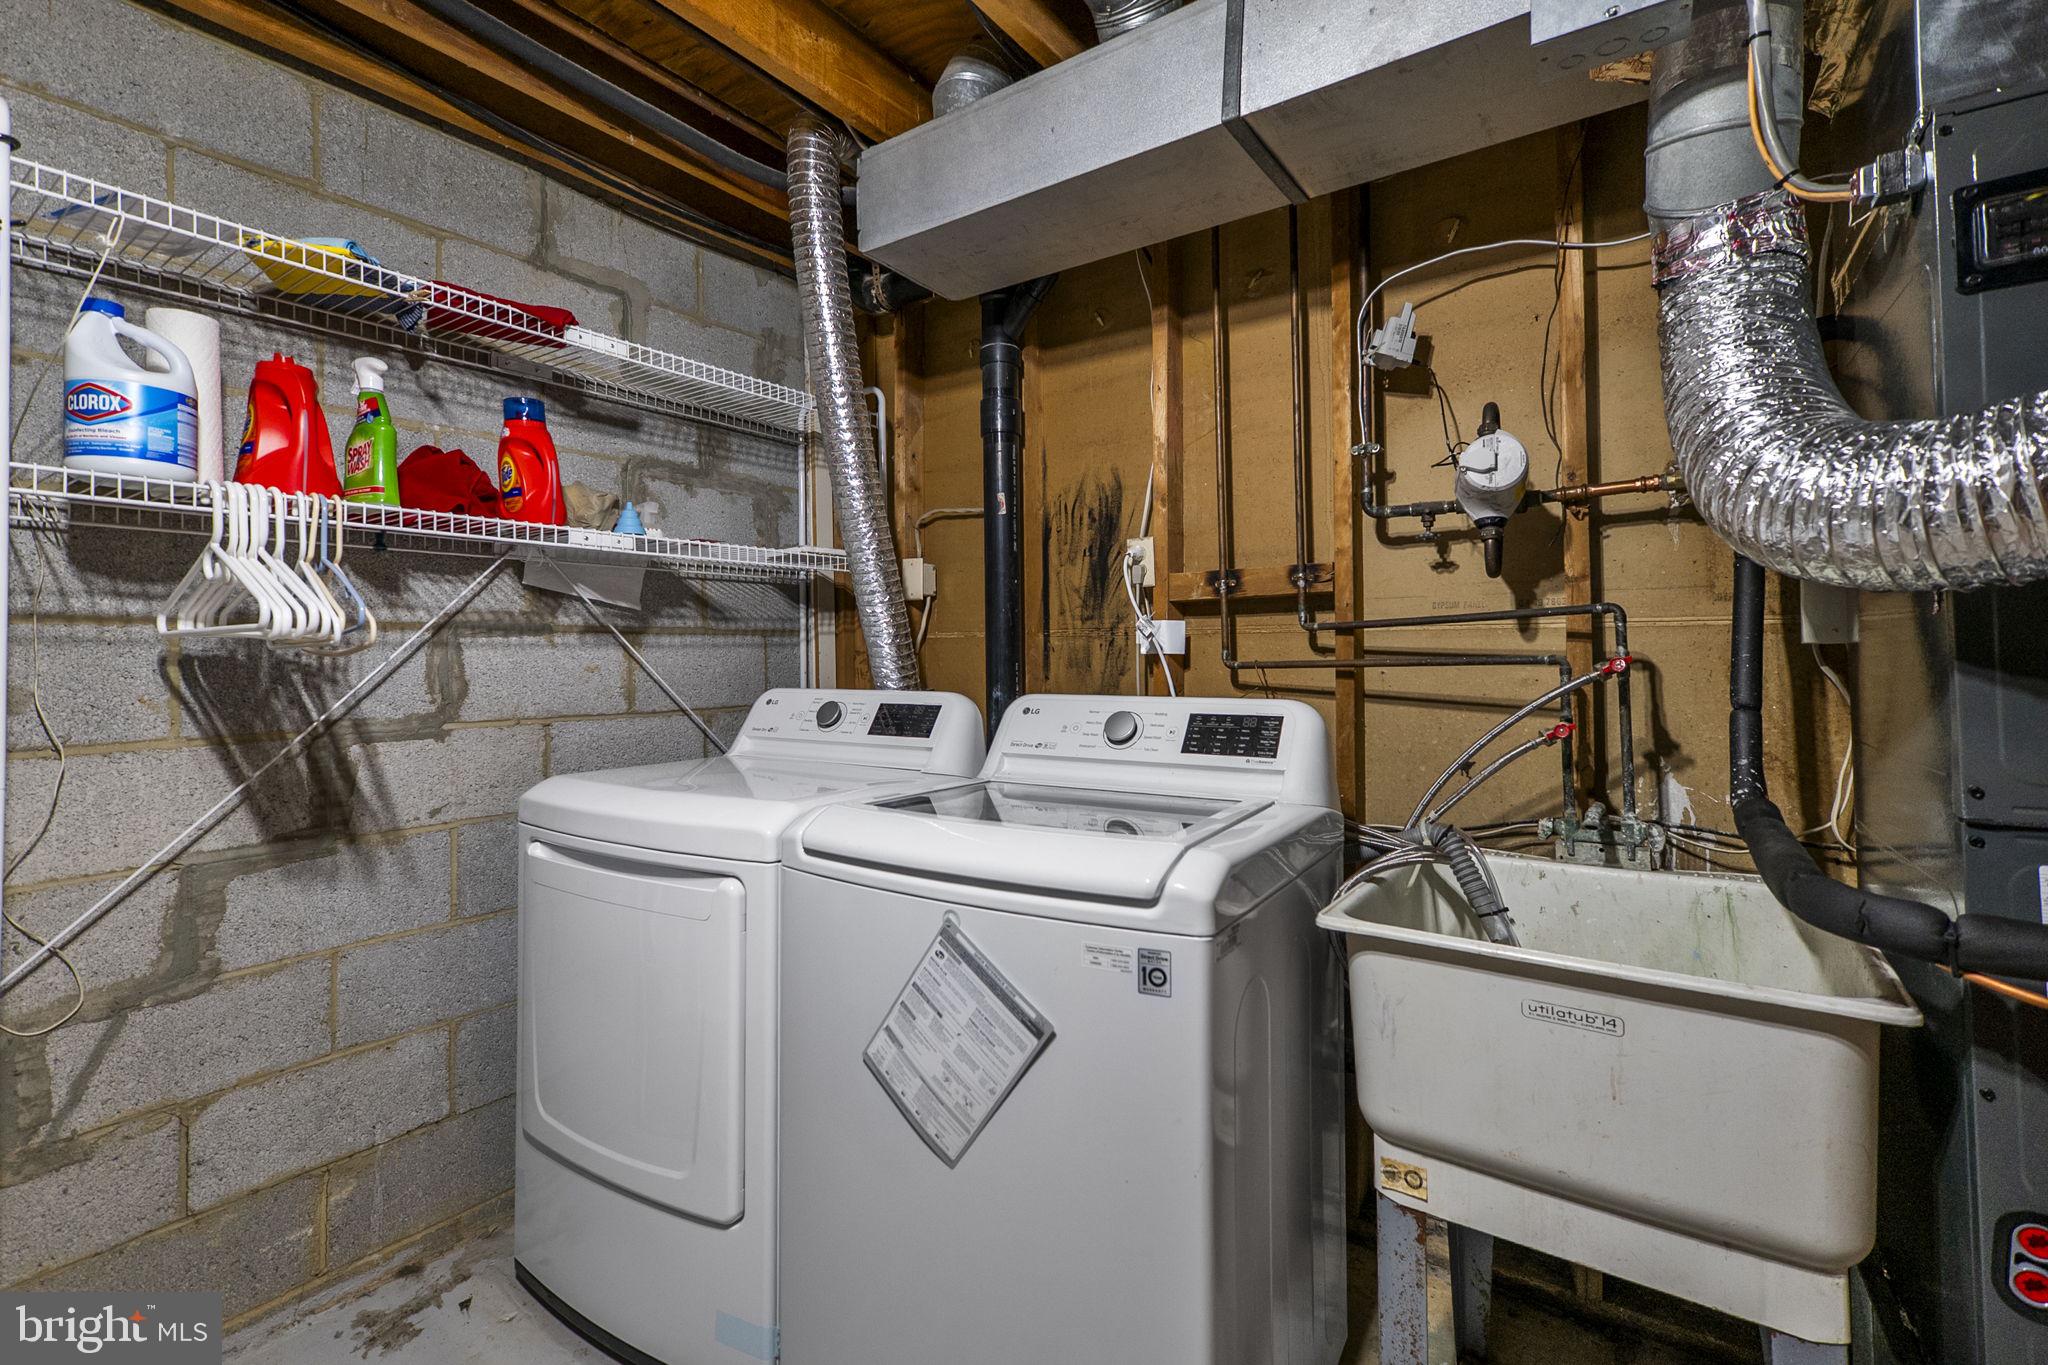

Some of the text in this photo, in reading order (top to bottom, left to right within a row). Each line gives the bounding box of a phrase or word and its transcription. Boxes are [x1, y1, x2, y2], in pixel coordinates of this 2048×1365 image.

[67, 393, 121, 412] CLOROX
[348, 441, 372, 463] SPRAY
[348, 456, 370, 476] WASH
[1142, 966, 1167, 987] 10
[1601, 1017, 1617, 1028] 14
